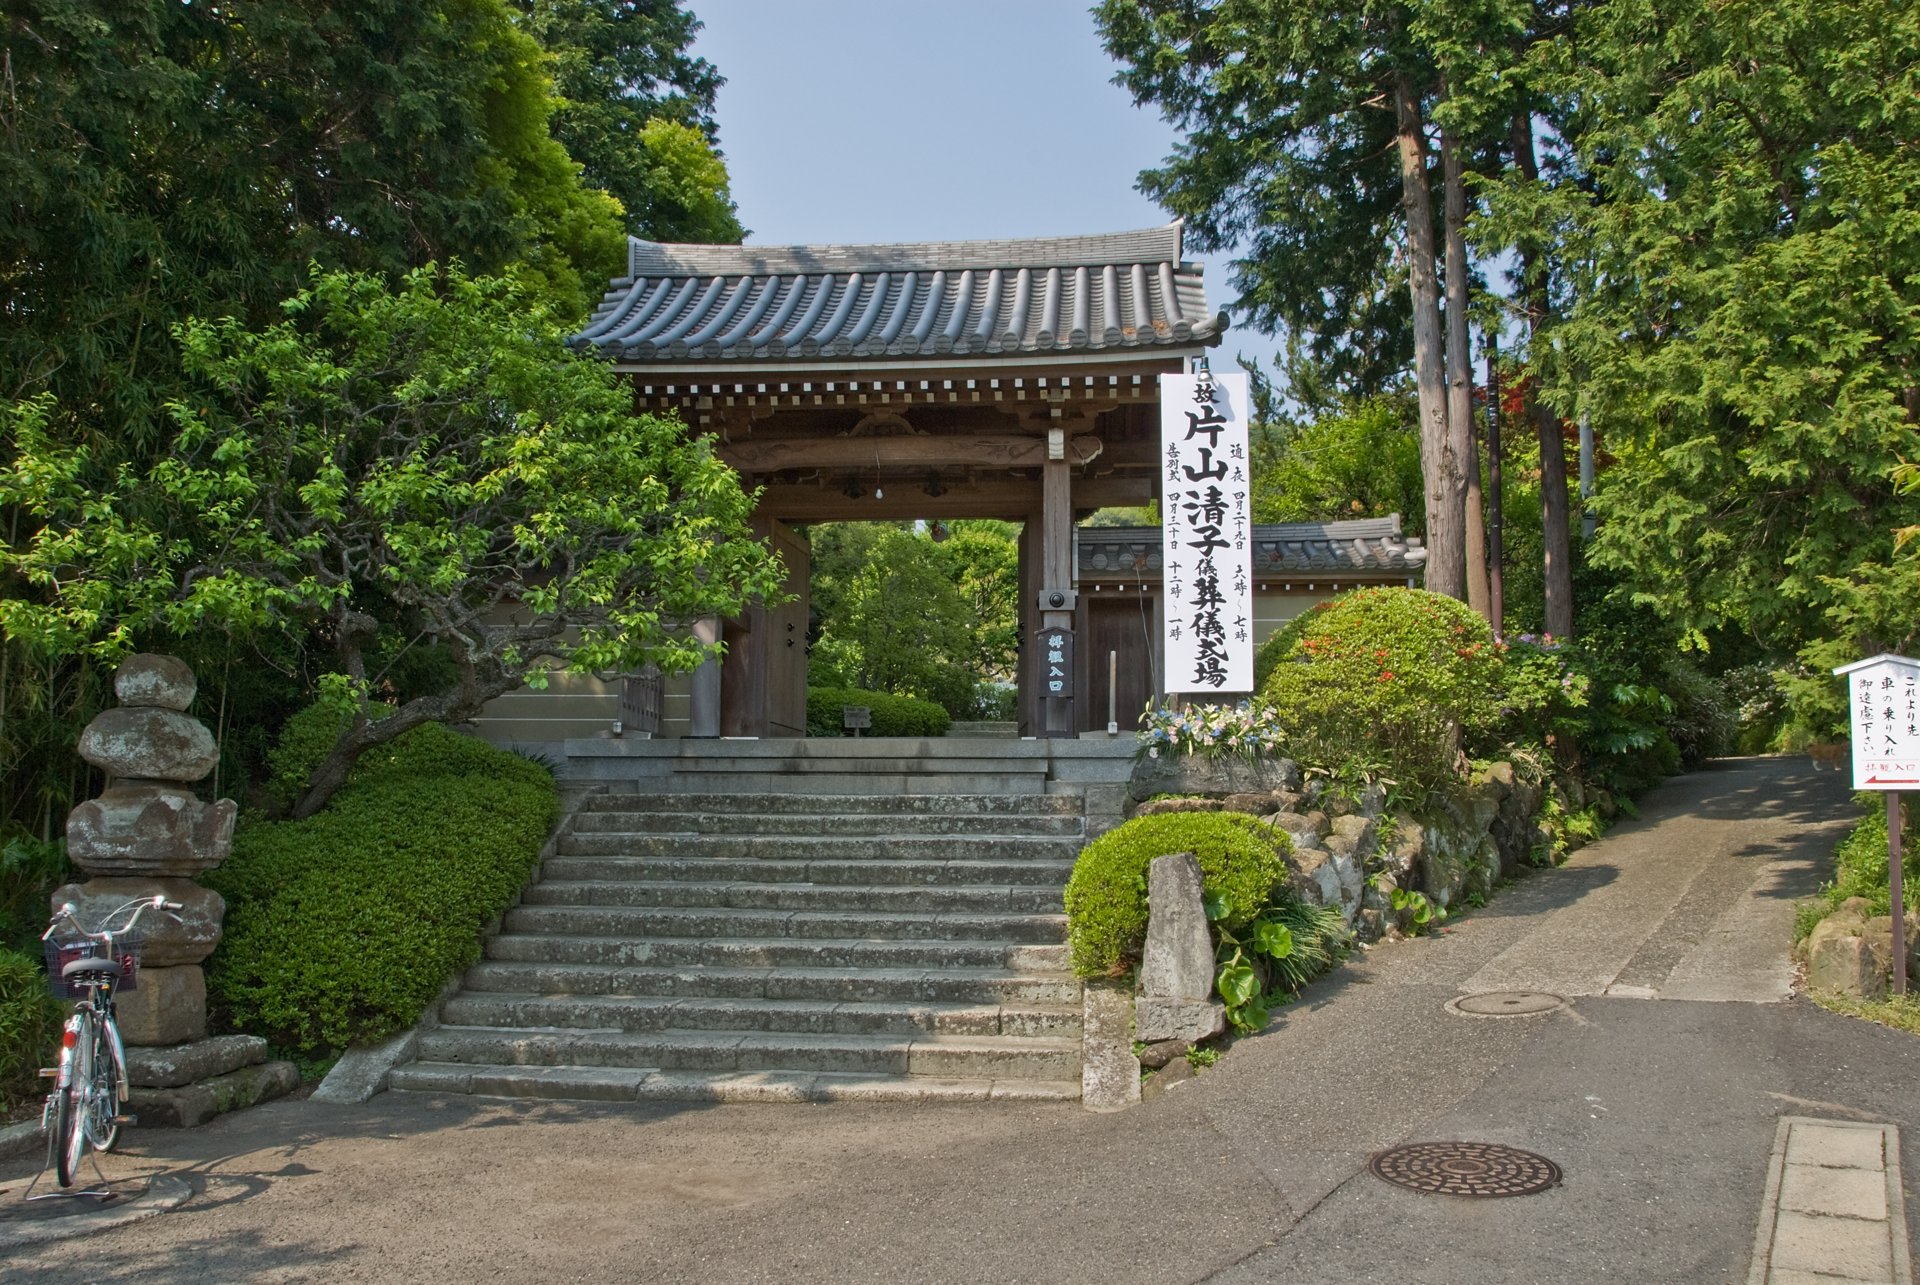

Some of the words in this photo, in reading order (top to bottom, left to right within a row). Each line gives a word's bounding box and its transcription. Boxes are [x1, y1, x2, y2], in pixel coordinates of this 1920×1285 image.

[1166, 442, 1180, 482] 告別式
[1230, 443, 1245, 482] 通夜
[1167, 492, 1180, 550] 四月三十日
[1232, 491, 1247, 550] 四月二十九日
[1048, 634, 1064, 691] 拝観入口
[1881, 676, 1897, 756] 車の乗り入れ
[1905, 676, 1919, 737] これより先
